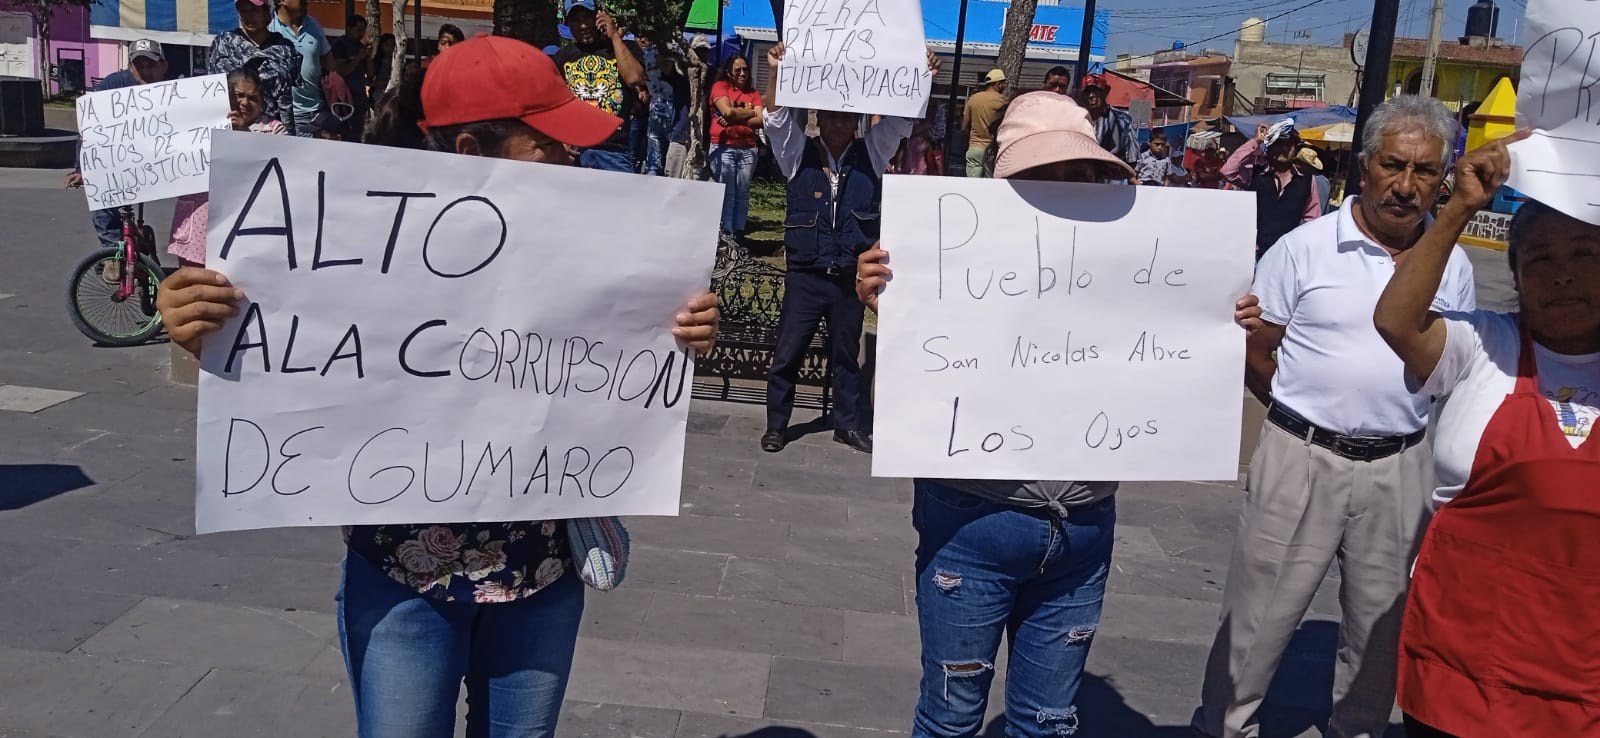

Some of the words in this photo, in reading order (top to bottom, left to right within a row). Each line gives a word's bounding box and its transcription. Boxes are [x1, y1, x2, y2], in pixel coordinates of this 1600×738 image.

[784, 28, 876, 63] RATAS
[1028, 24, 1060, 43] ATE
[779, 64, 850, 94] FUERA
[1522, 27, 1600, 126] PR
[79, 97, 99, 126] YA
[111, 82, 187, 118] BASTA
[202, 80, 226, 99] YA
[80, 111, 173, 149] ESTAMOS
[82, 144, 143, 171] ARTOS
[154, 132, 179, 157] DE
[219, 157, 507, 278] ALTO
[938, 192, 1093, 300] Pueblo
[1133, 237, 1187, 287] de
[224, 302, 364, 379] ALA
[399, 319, 690, 409] CORRUPSION
[922, 335, 979, 372] San
[1011, 331, 1100, 369] Nicolas
[1128, 331, 1192, 363] Abre
[947, 396, 1034, 457] Los
[1085, 411, 1159, 451] Ojos
[222, 418, 324, 498] DE
[347, 427, 635, 505] GUMARO
